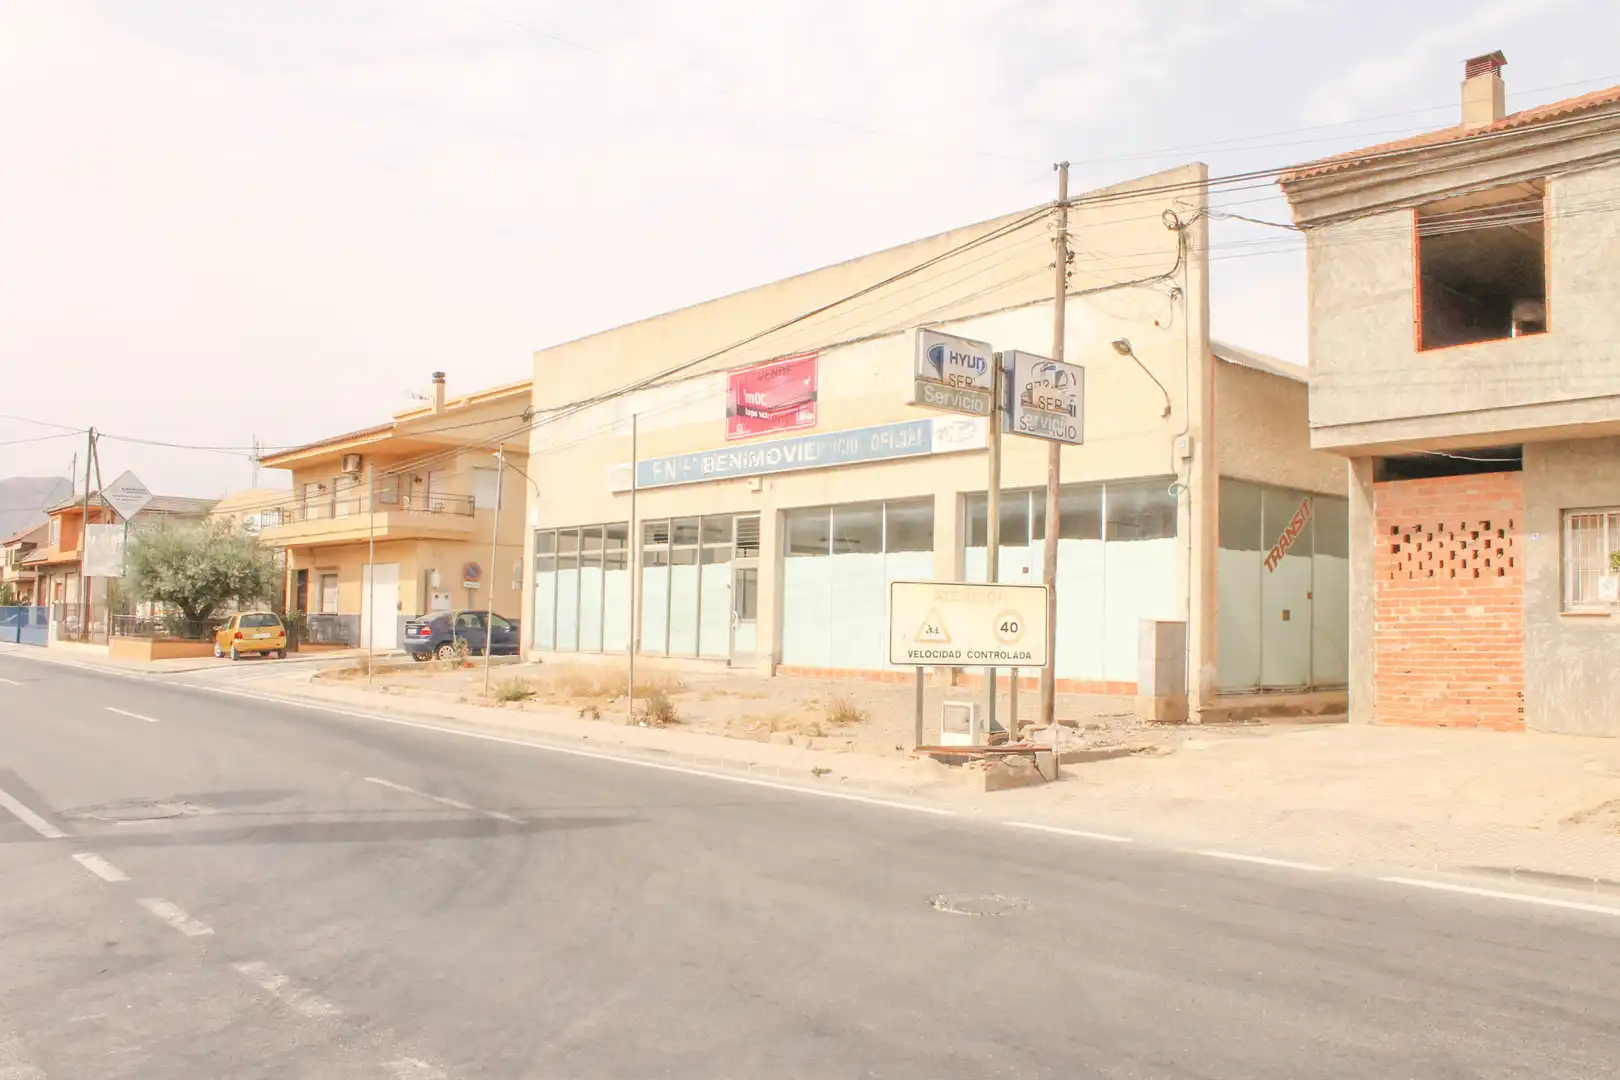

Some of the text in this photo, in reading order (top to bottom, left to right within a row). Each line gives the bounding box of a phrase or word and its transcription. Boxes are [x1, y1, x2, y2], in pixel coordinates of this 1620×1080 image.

[924, 384, 984, 412] Servicio
[1264, 499, 1311, 574] TRANSIT
[1000, 621, 1018, 633] 40
[907, 649, 1032, 661] VELOCIDAD CONTROLADA
